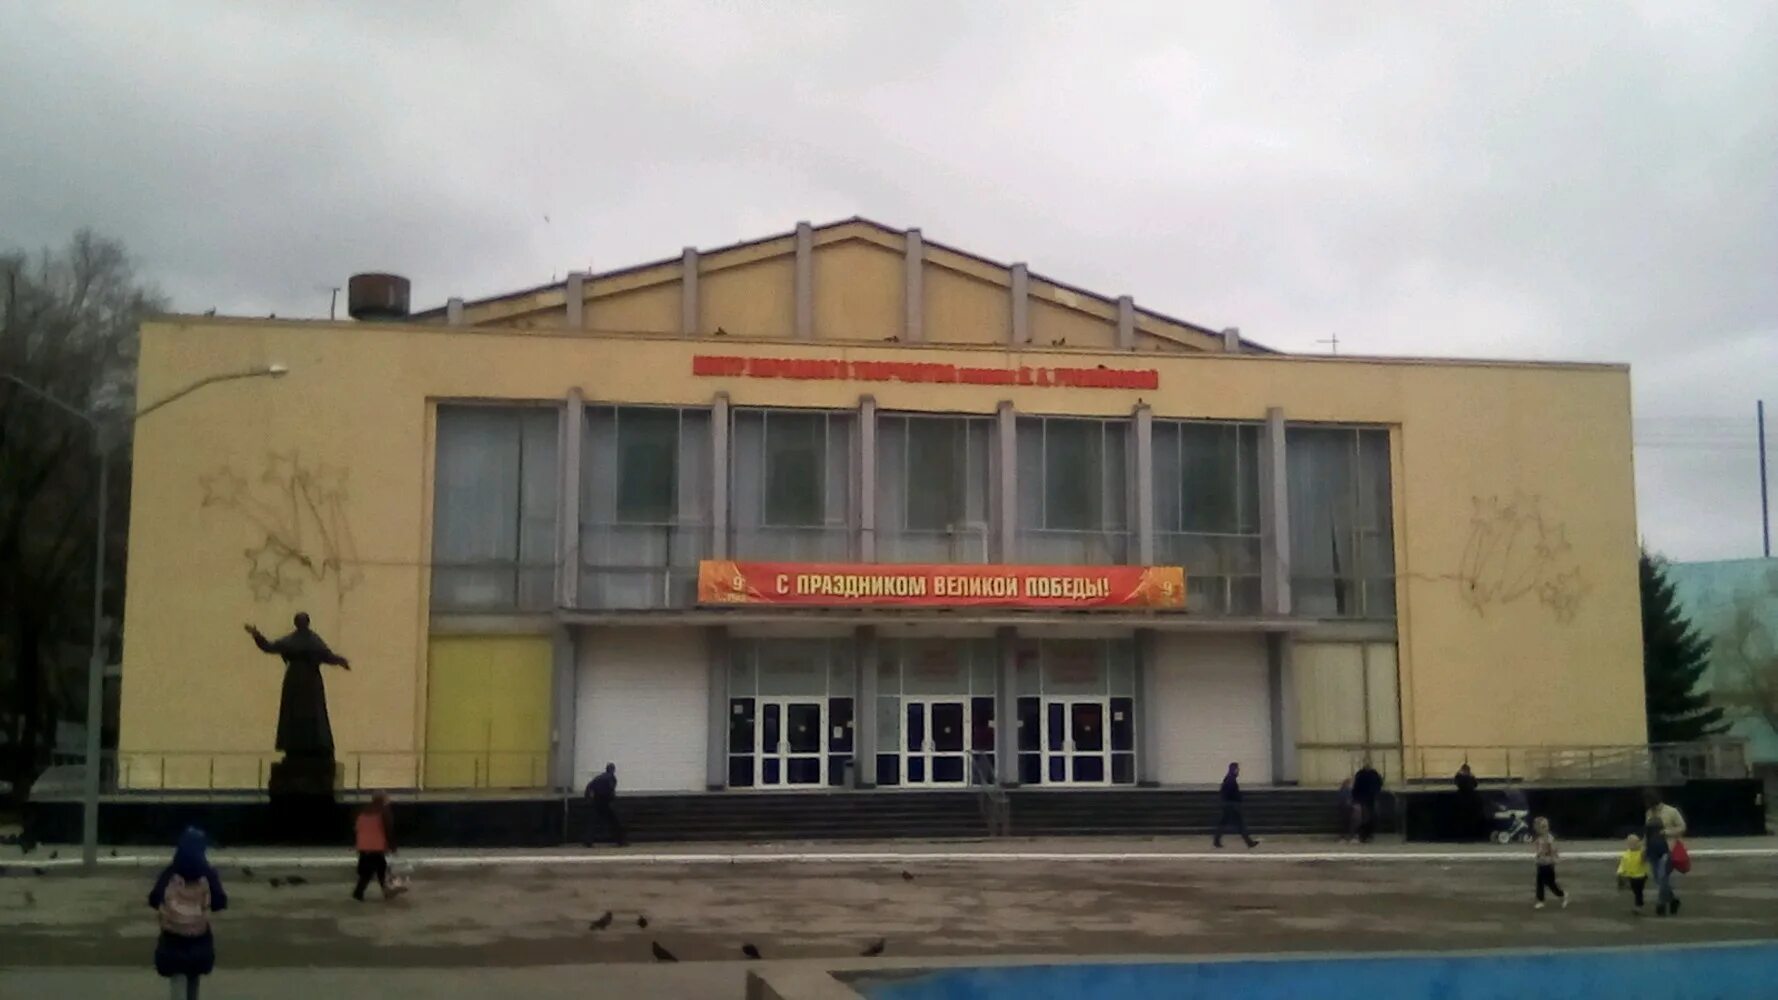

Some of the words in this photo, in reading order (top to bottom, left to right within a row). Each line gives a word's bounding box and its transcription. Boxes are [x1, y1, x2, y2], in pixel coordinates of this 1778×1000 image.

[733, 576, 743, 591] 9
[776, 574, 788, 594] С
[797, 575, 926, 598] ПРАЗДНИКОМ
[933, 575, 1018, 597] ВЕЛИКОЙ
[1025, 577, 1110, 600] ПОБЕДЫ!
